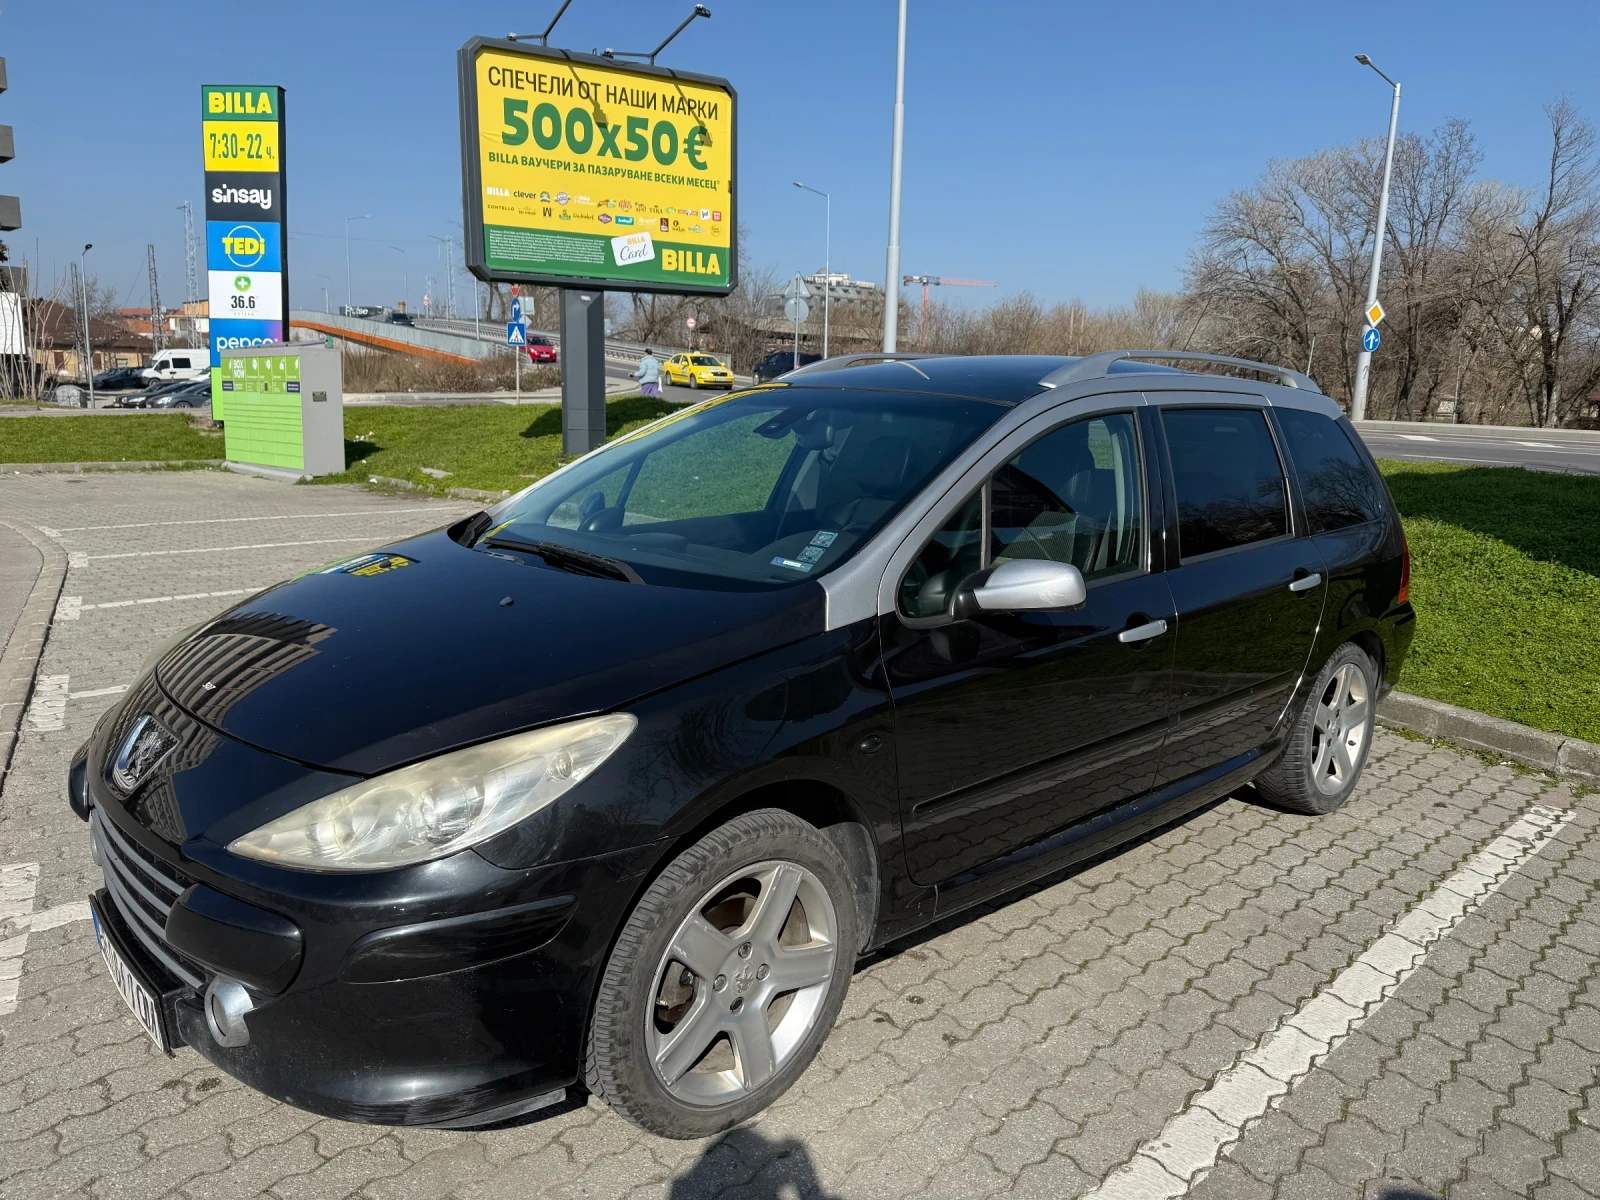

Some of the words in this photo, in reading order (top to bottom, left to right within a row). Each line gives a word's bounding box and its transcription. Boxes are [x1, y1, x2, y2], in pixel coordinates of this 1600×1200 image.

[208, 91, 273, 114] BILLA
[488, 65, 573, 98] СПЕЧЕЛИ
[578, 80, 601, 101] ОТ
[606, 84, 657, 111] НАШИ
[662, 93, 718, 121] МАРКИ
[266, 146, 275, 160] ч.
[488, 151, 519, 165] BILLA
[520, 155, 571, 172] ВАУЧЕРИ
[572, 162, 586, 174] ЗА
[587, 163, 653, 182] ПАЗАРУВАНЕ
[654, 172, 685, 186] ВСЕКИ
[212, 183, 272, 210] sinsay
[486, 186, 510, 197] BILLA
[513, 189, 537, 200] clever
[222, 236, 266, 256] TEDi
[626, 236, 646, 246] BILLA
[620, 243, 648, 261] Card
[661, 248, 721, 275] BILLA
[233, 359, 244, 369] BOX
